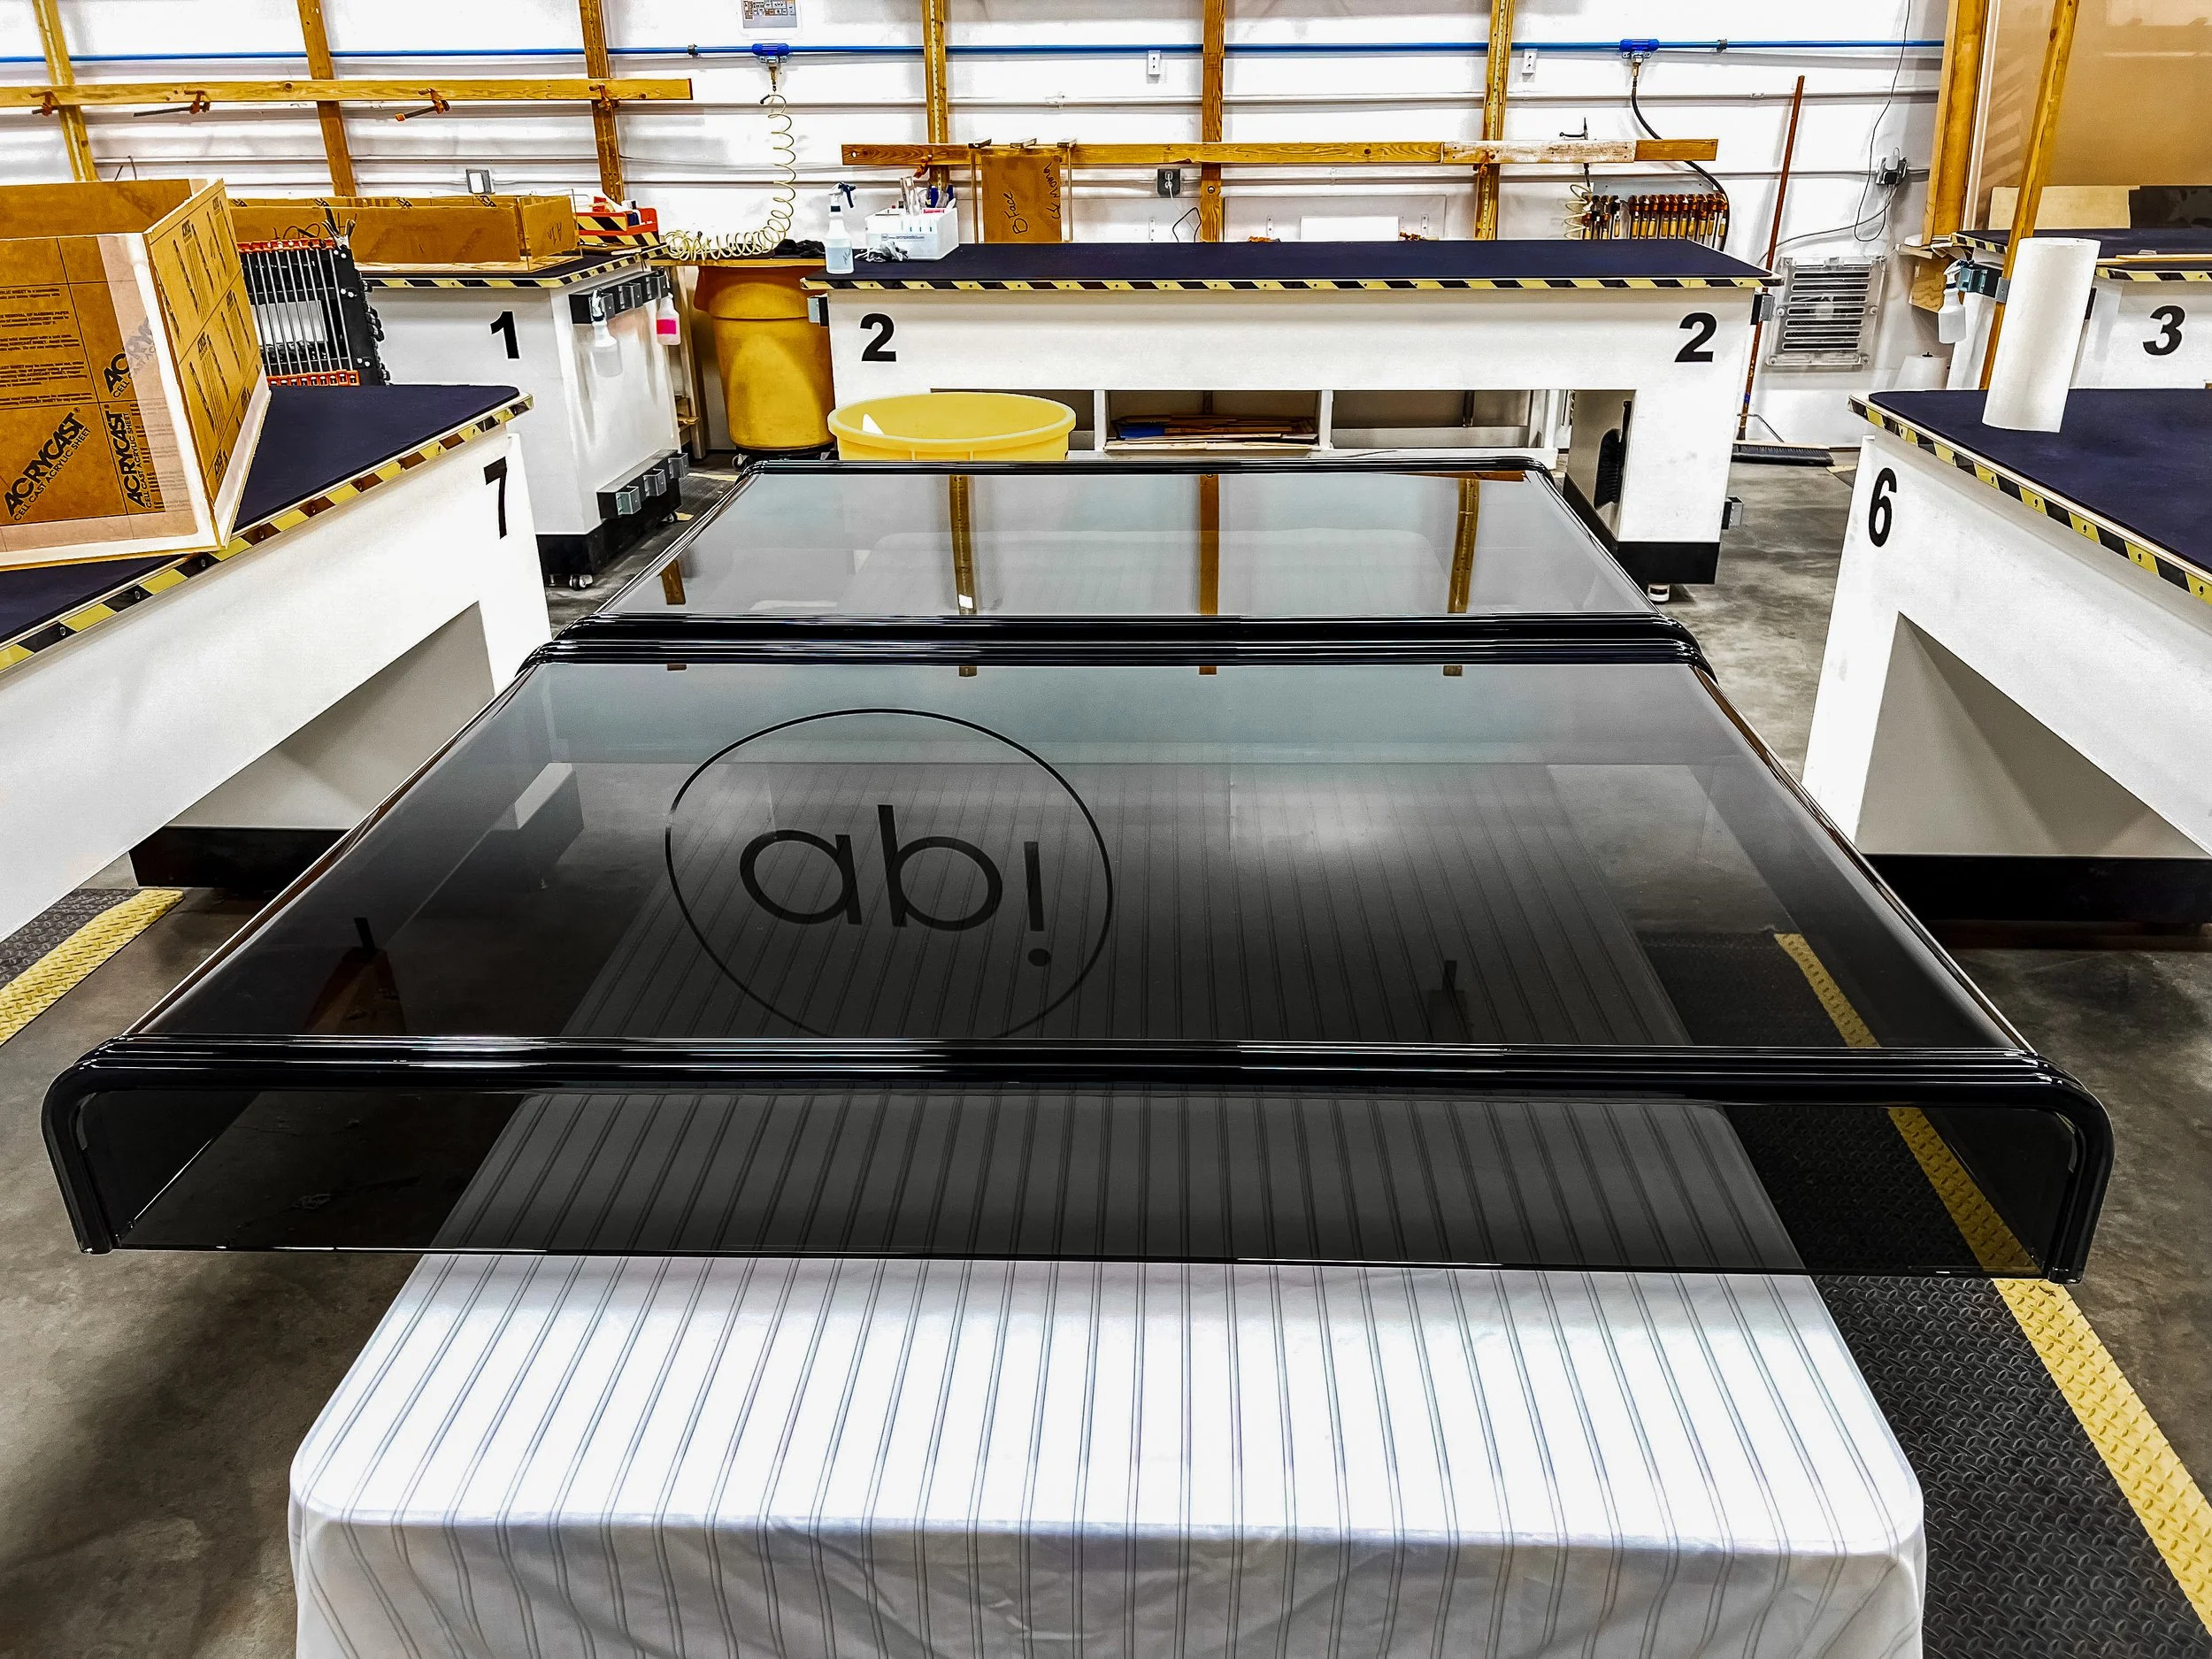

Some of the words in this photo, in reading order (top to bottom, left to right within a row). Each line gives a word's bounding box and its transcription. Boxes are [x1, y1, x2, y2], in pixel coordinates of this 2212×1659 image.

[490, 311, 519, 359] 1
[860, 313, 896, 362] 2
[1675, 312, 1717, 362] 2
[2143, 305, 2185, 356] 3
[112, 380, 130, 398] CELL
[123, 412, 133, 434] SHEET
[4, 411, 86, 518] ACRYCAST
[14, 503, 31, 521] CELL
[28, 484, 47, 503] CAST
[46, 449, 73, 484] ACRYLIC
[71, 426, 91, 450] SHEET
[105, 411, 146, 508] ACRYCAST
[129, 434, 142, 469] ACRYLIC
[137, 471, 147, 490] CAST
[141, 490, 152, 509] CELL
[484, 456, 507, 540] 7
[1869, 467, 1897, 548] 6
